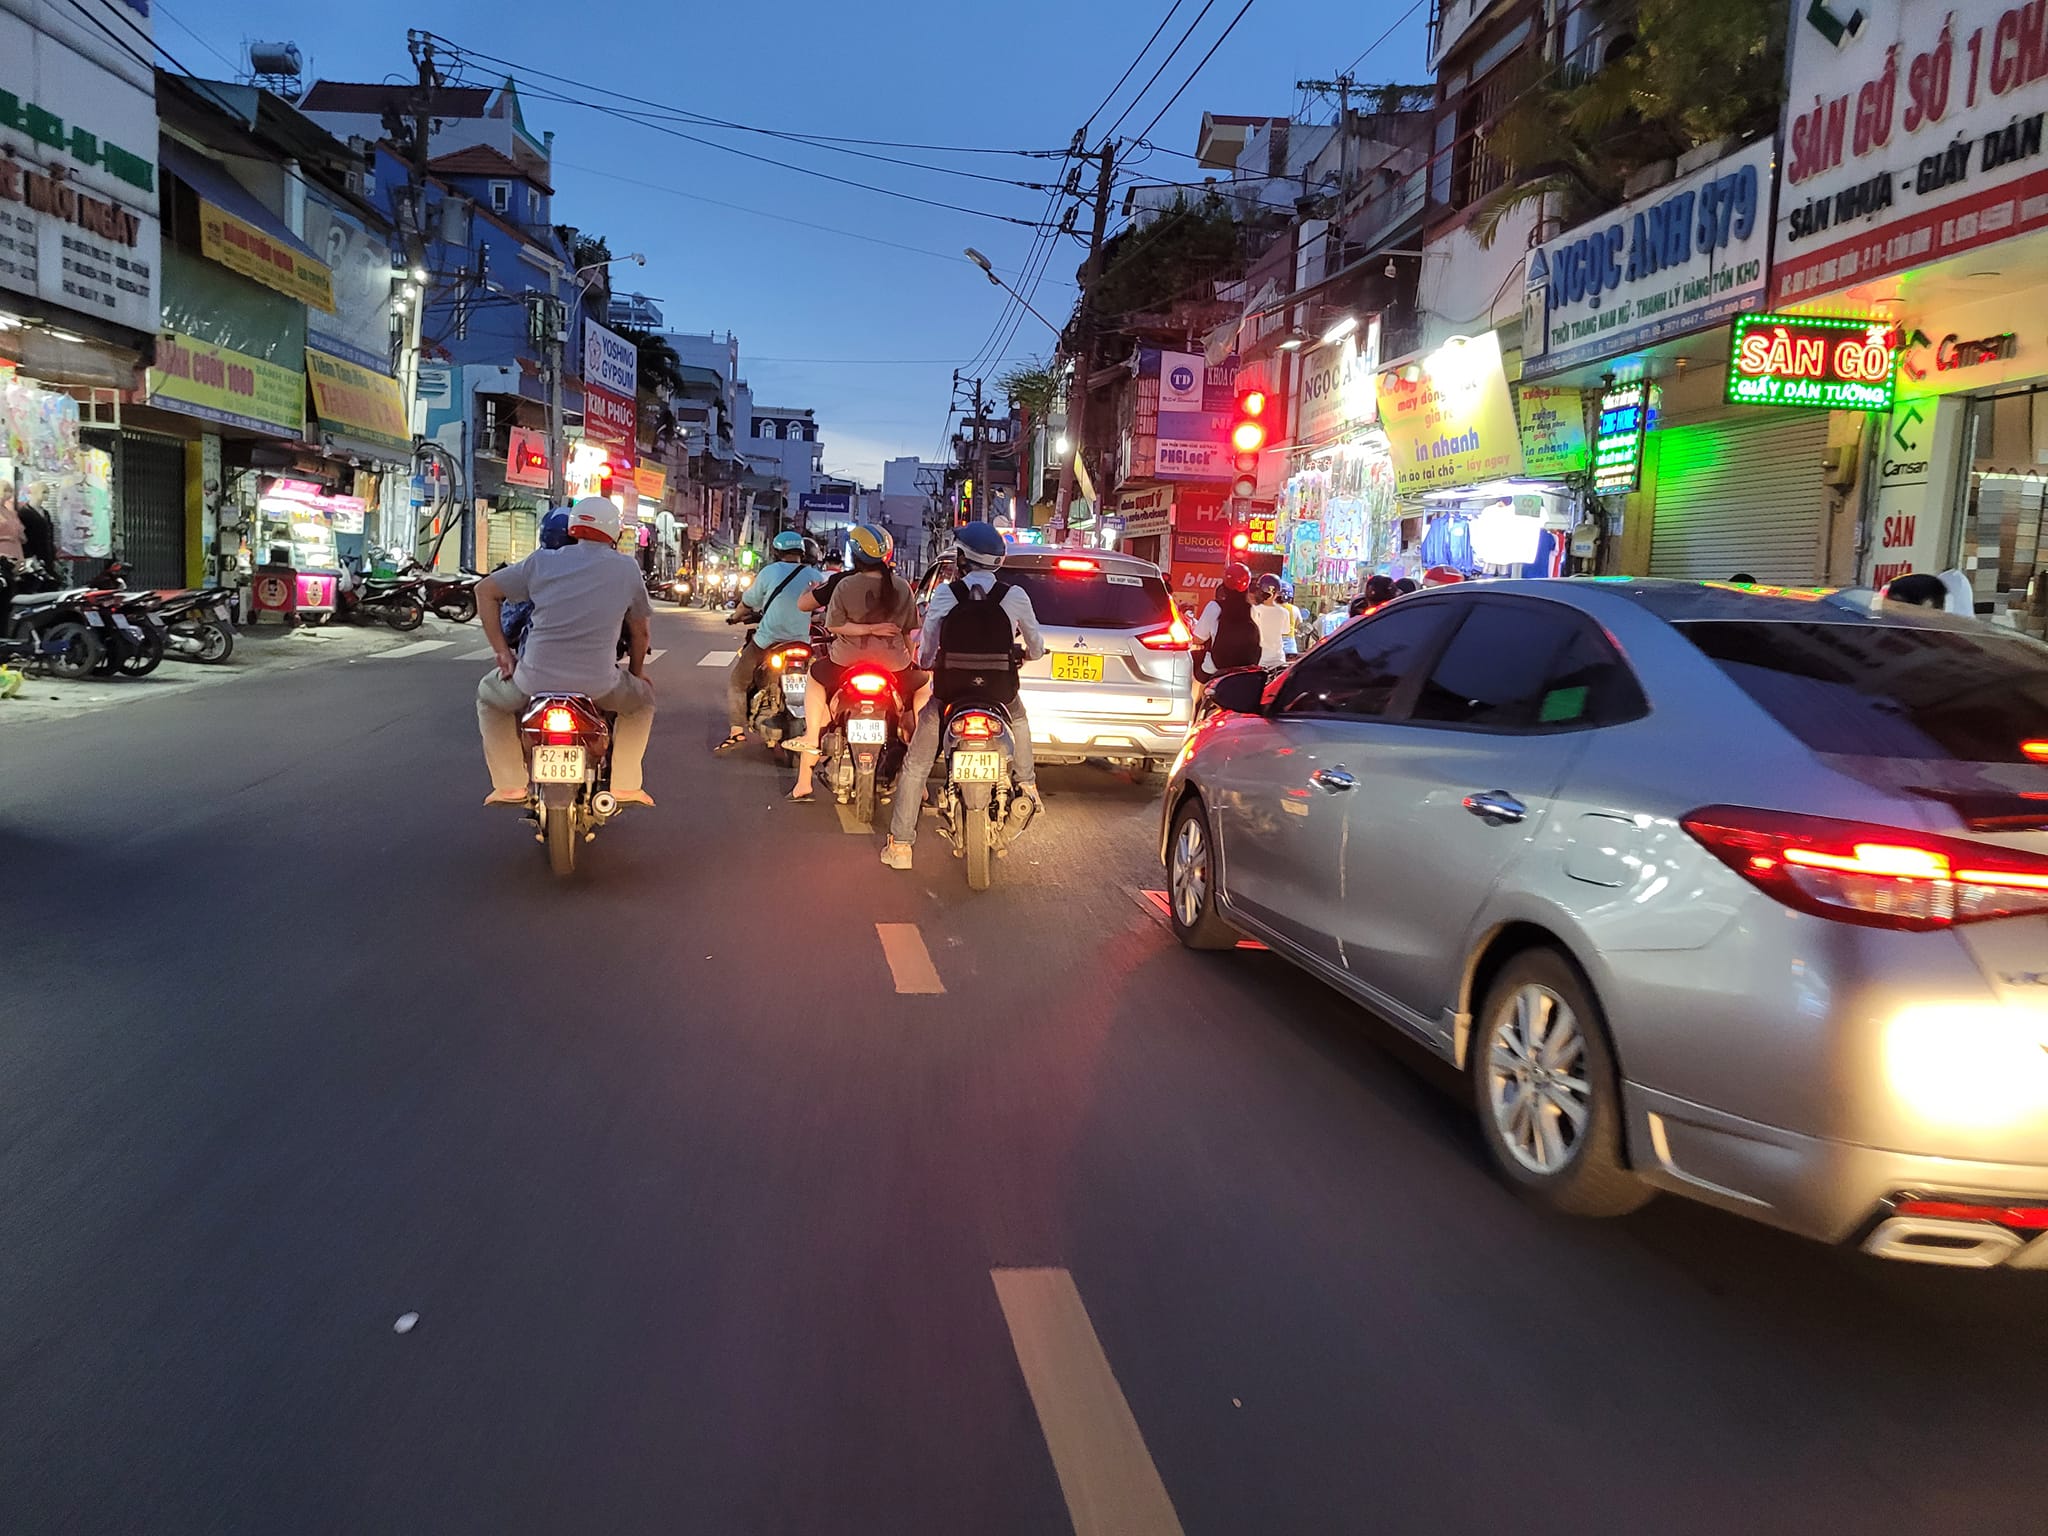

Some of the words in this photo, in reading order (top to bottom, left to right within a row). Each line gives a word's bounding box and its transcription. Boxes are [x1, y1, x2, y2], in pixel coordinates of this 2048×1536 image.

[1853, 43, 1898, 157] GỖ
[1904, 11, 1953, 132] SỐ
[1966, 27, 1983, 108] 1
[1834, 172, 1893, 223] NHỰA
[1916, 130, 1973, 195] GIẤY
[1982, 115, 2045, 172] DÁN
[1550, 225, 1624, 310] NGỌC
[1625, 190, 1695, 282] ANH
[1696, 164, 1758, 254] 879
[1552, 320, 1570, 346] THỜI
[1571, 316, 1597, 339] TRANG
[1598, 312, 1617, 334] NAM
[1636, 299, 1668, 322] THANH
[1668, 286, 1681, 308] LÝ
[1682, 274, 1709, 304] HÀNG
[1712, 262, 1734, 294] TỒN
[1736, 258, 1761, 285] KHO
[602, 335, 634, 369] YOSHINO
[1740, 328, 1825, 377] SÀN
[1834, 325, 1889, 381] GỖ
[601, 360, 634, 390] GYPSUM
[1173, 374, 1191, 385] TD
[1304, 363, 1340, 404] NGỌC
[1397, 397, 1418, 411] may
[1784, 379, 1821, 399] DÁN
[1824, 382, 1885, 403] TƯỜNG
[607, 402, 634, 427] PHÚC
[1415, 438, 1429, 462] in
[1432, 427, 1480, 458] nhanh
[1526, 445, 1534, 456] in
[1538, 441, 1569, 455] nhanh
[1398, 471, 1407, 483] in
[1484, 454, 1510, 469] ngay
[1882, 459, 1928, 478] Camsan
[1882, 510, 1916, 548] SÀN
[1057, 667, 1098, 680] 215.67
[1067, 655, 1089, 666] 51H
[541, 764, 577, 778] 4885
[956, 767, 996, 779] 384.21
[960, 754, 992, 766] 77-H1
